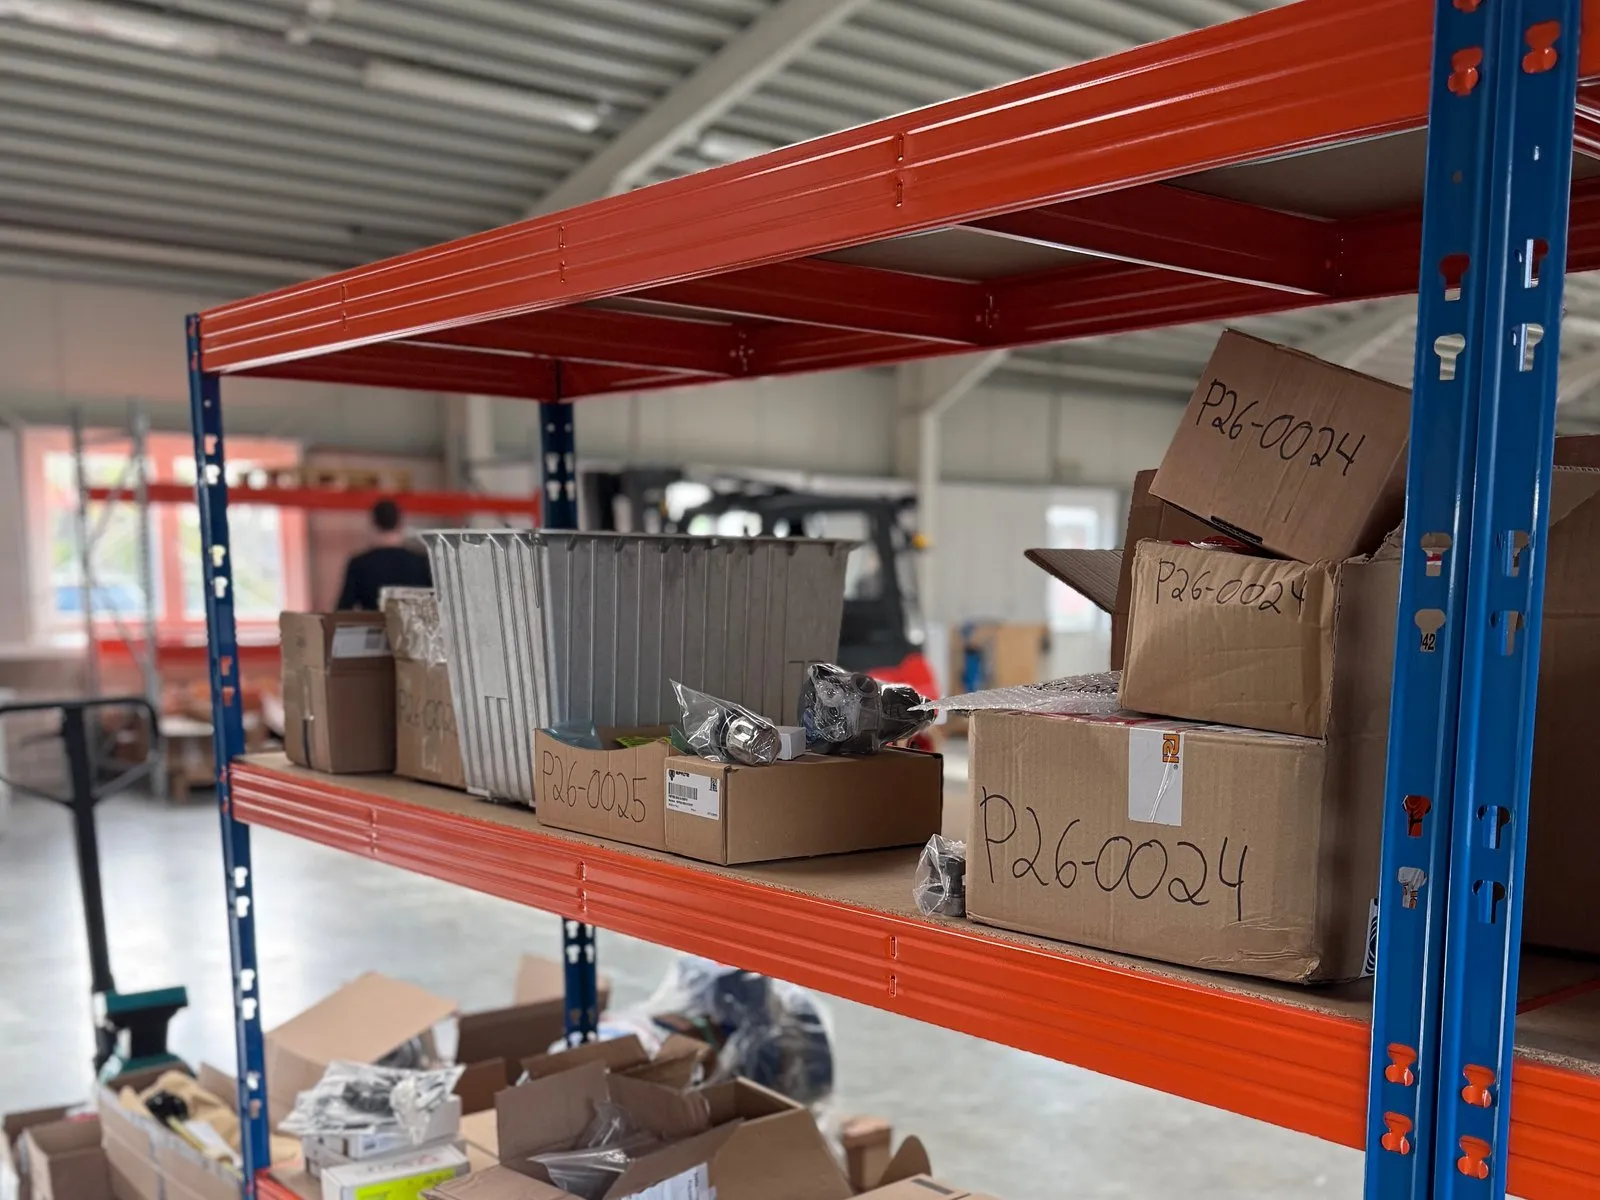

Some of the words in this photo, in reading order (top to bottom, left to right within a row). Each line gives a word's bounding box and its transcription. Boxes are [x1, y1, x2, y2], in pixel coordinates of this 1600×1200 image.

[1195, 378, 1366, 476] P26-0024
[1155, 558, 1307, 615] P26-0024
[1420, 632, 1437, 651] 42
[542, 750, 647, 823] P26-0025
[979, 786, 1249, 922] P26-0024
